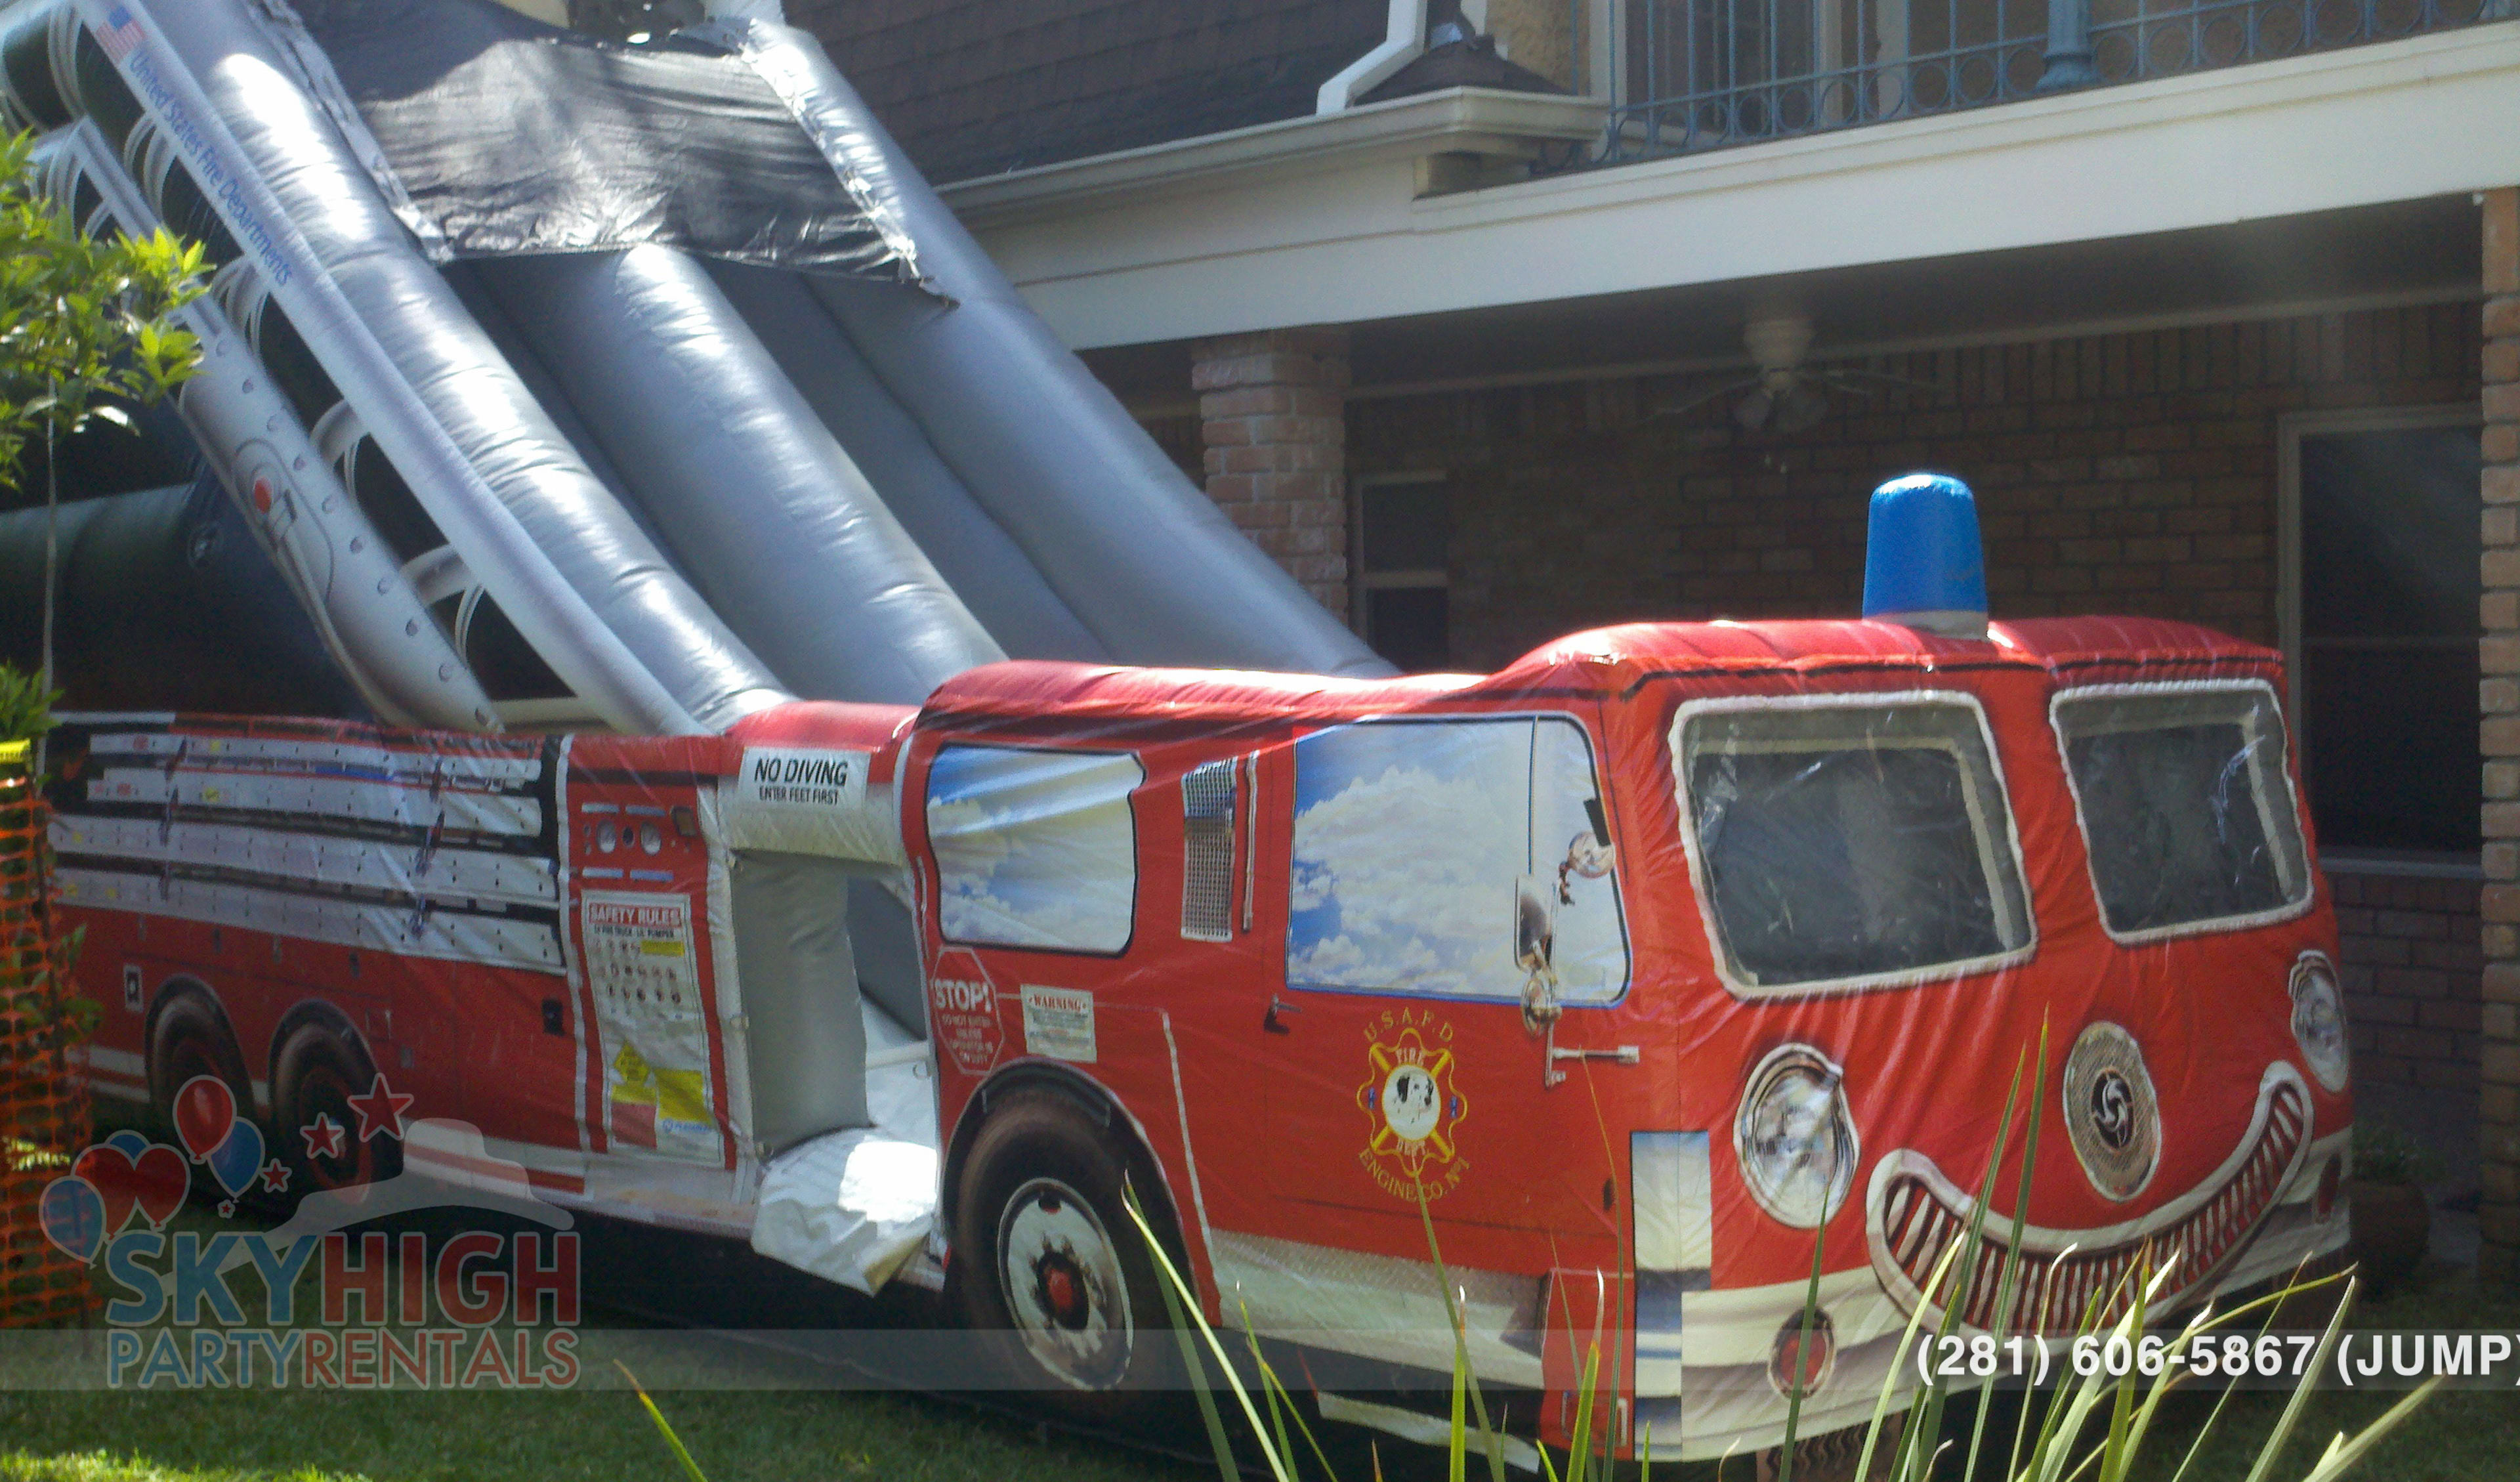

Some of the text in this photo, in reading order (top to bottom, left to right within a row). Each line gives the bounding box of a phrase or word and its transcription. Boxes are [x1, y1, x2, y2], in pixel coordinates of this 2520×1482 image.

[131, 51, 292, 287] United States Fire Departments
[755, 757, 849, 787] NO DIVING
[759, 786, 839, 805] ENTER FEET FIRST
[591, 904, 680, 926] SAFETY RULES
[934, 979, 992, 1013] STOP!
[1359, 1148, 1418, 1202] ENGINE
